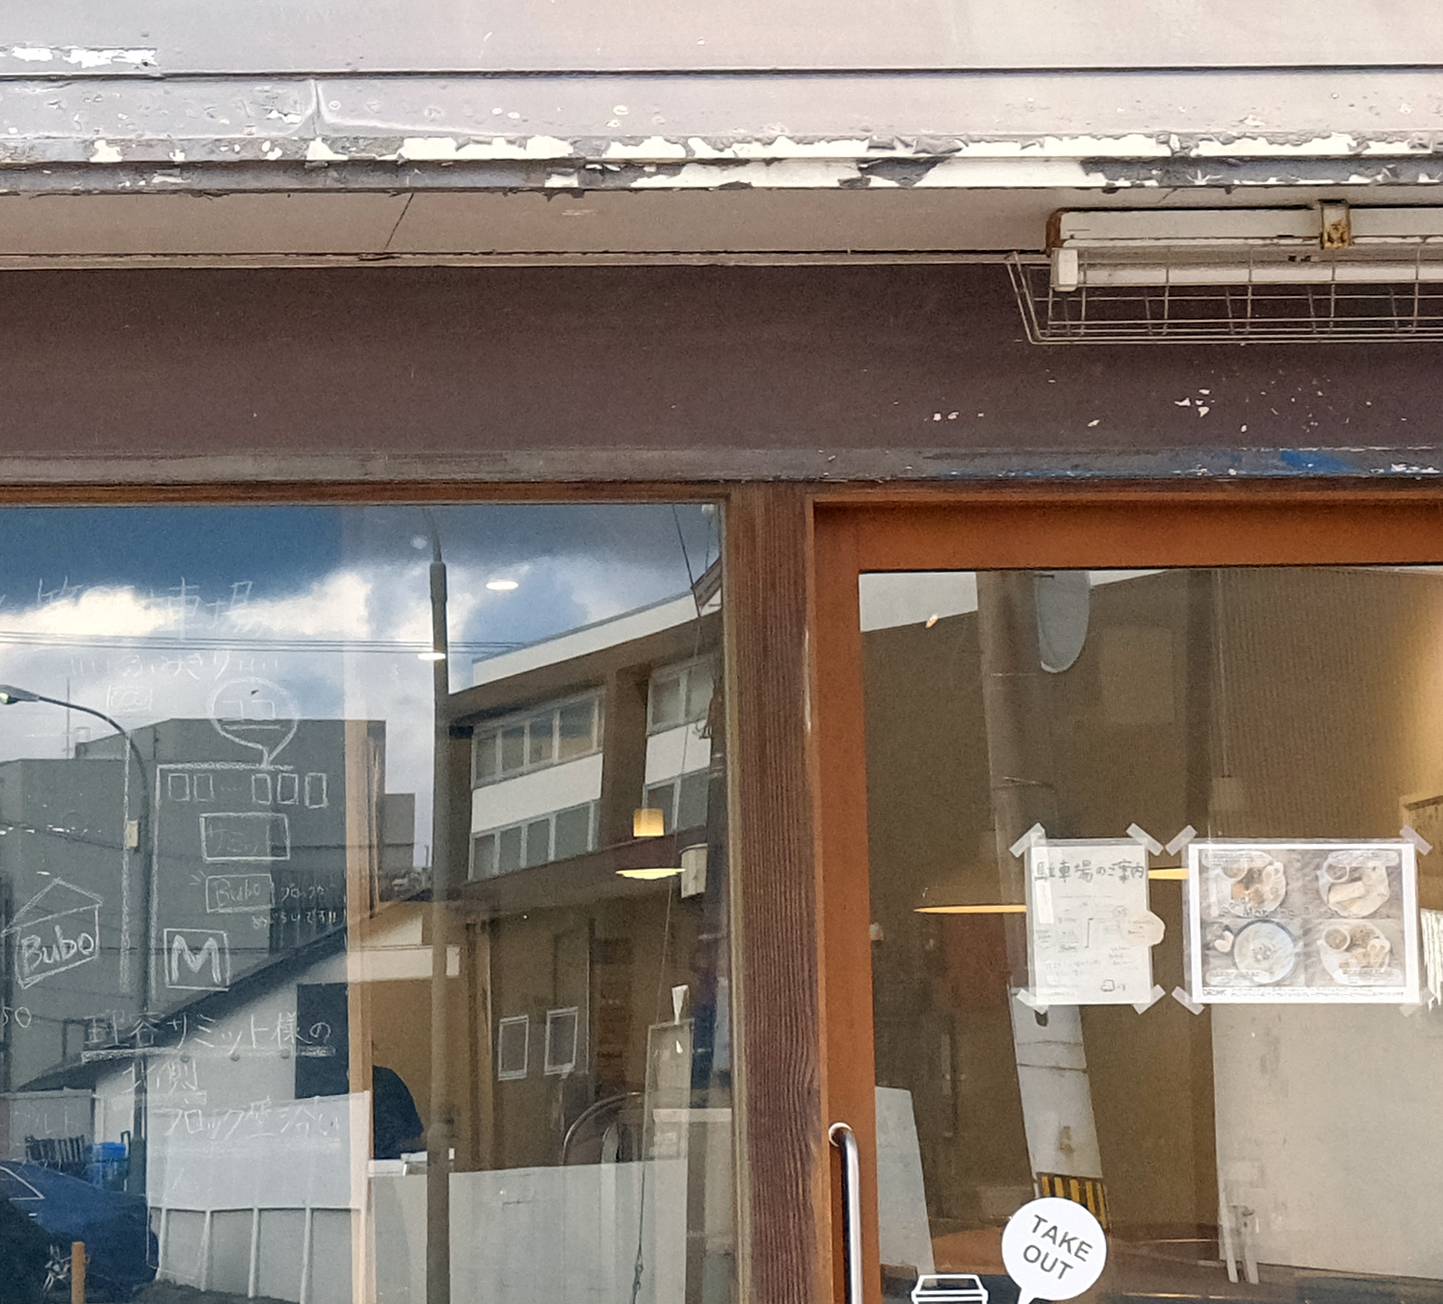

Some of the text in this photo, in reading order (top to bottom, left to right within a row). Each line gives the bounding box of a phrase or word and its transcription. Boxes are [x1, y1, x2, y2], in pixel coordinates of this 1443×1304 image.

[1034, 859, 1145, 884] 駐車場のご案内
[19, 924, 96, 974] Bubo
[1031, 1213, 1094, 1264] TAKE
[1021, 1241, 1076, 1282] OUT
